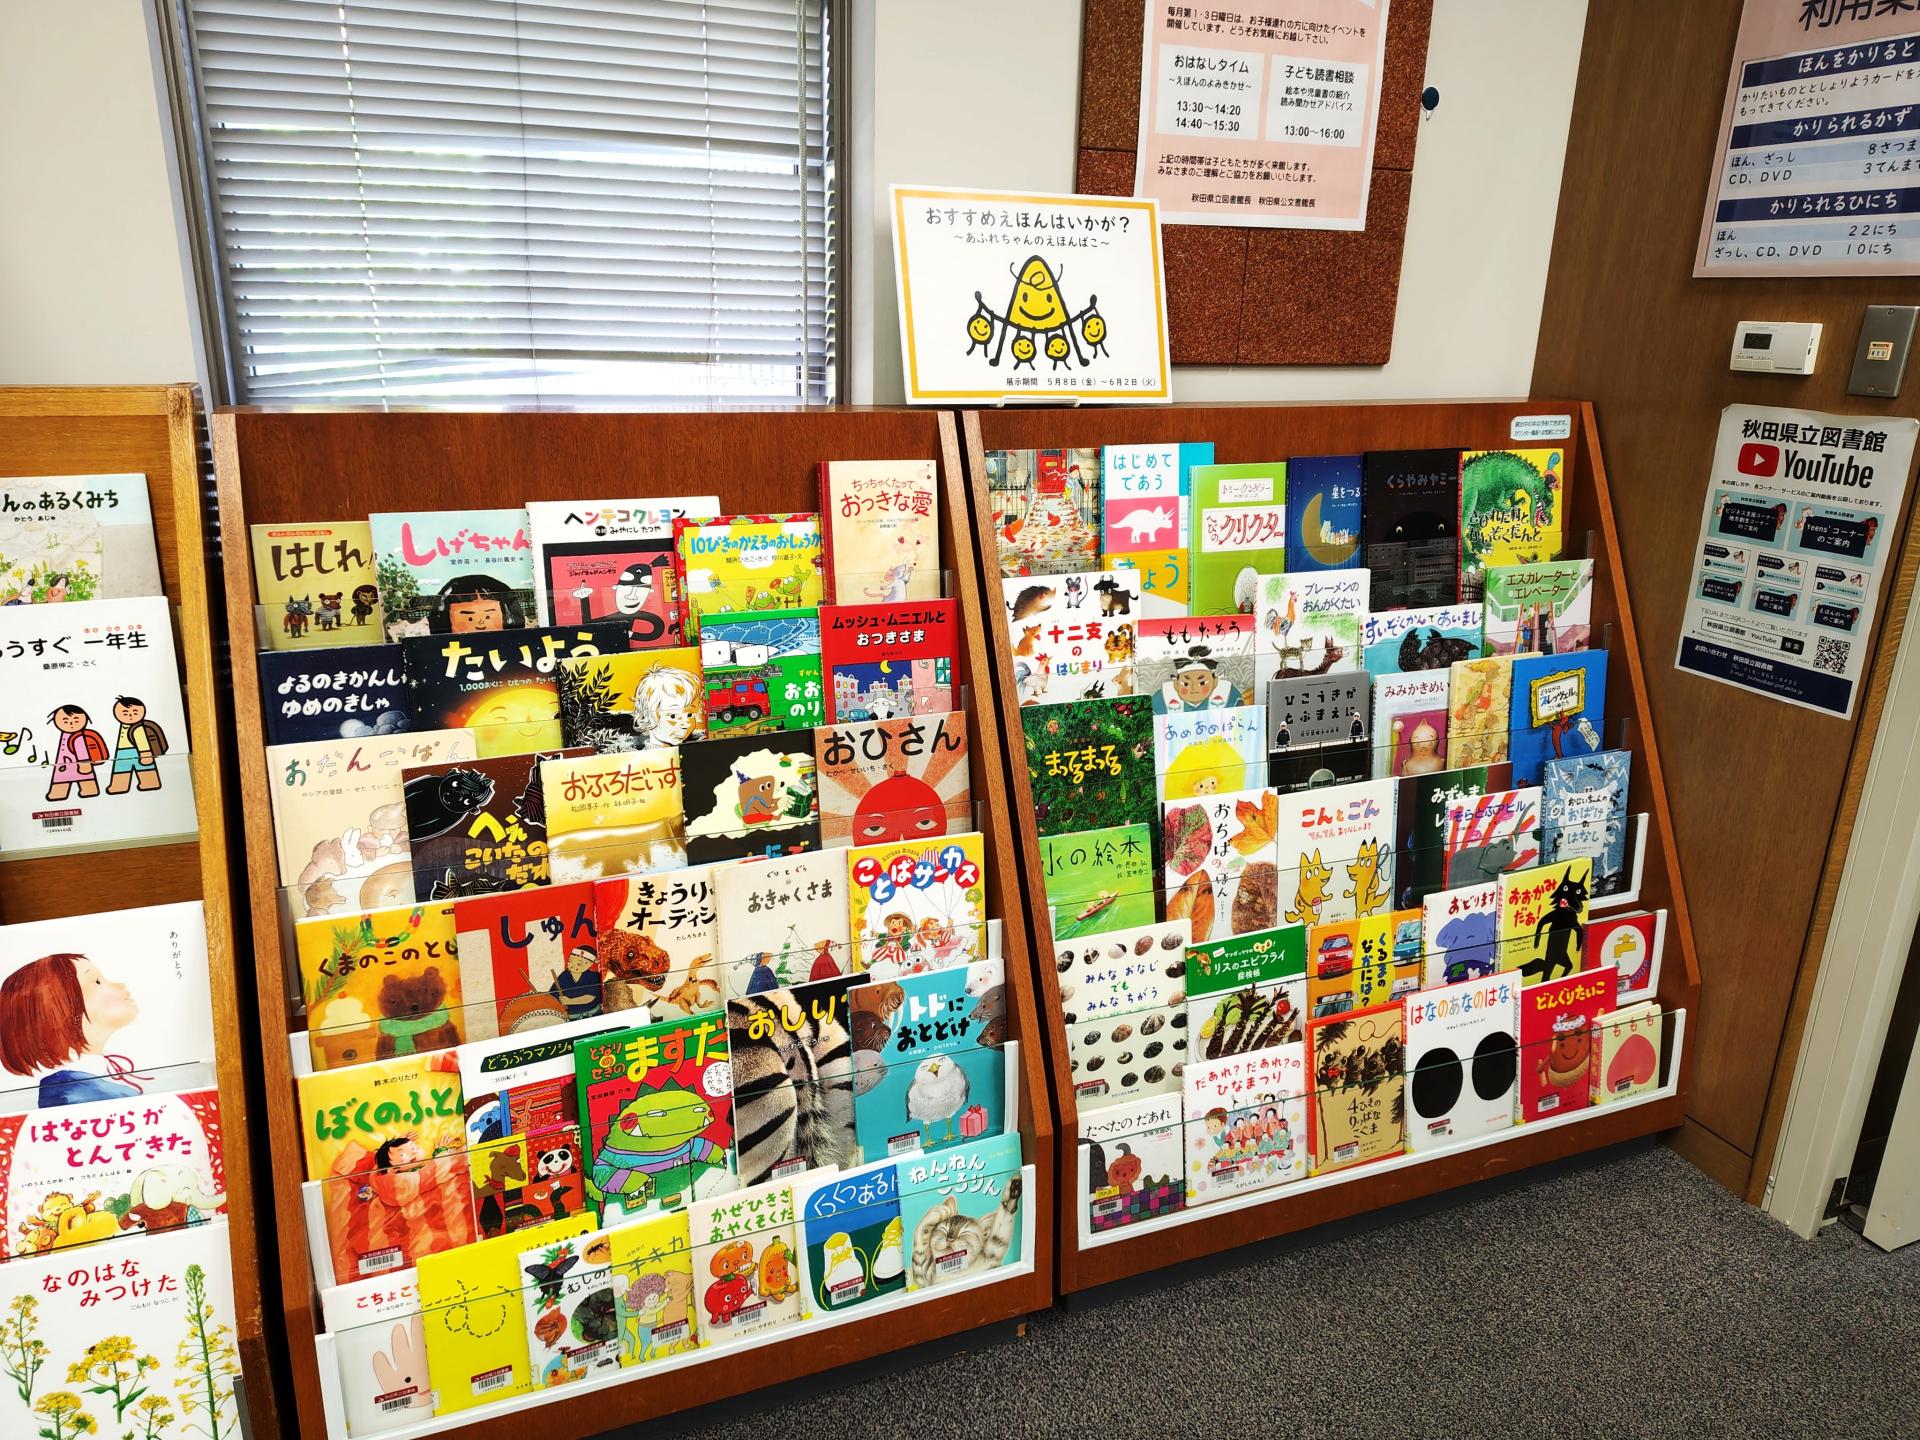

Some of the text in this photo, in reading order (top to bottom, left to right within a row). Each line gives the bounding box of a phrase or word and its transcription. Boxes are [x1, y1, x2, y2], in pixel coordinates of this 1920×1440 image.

[1174, 55, 1249, 74] おはなしタイム
[1284, 65, 1355, 84] 子ども読書相談
[1280, 97, 1353, 111] 読み聞かせアドバイス
[1285, 86, 1350, 100] 絵本や児童書の紹介
[1740, 98, 1829, 117] もってきてください。
[1793, 106, 1912, 137] かりられるかず
[1770, 192, 1897, 215] かりられるひにち
[925, 207, 1130, 233] おすすめえほんはいかが？
[1717, 230, 1737, 241] ほん
[1006, 377, 1038, 387] 展示期間
[1741, 419, 1887, 453] 秋田県立図書館
[1113, 452, 1173, 470] はじめて
[1784, 448, 1874, 489] YouTube
[851, 478, 914, 490] ちっちゃくたって
[1121, 473, 1164, 491] であう
[2, 488, 119, 512] んのあるくみち
[840, 490, 932, 518] おっきな愛
[563, 508, 686, 528] ヘンテコクレヨン
[1219, 512, 1284, 546] クリクター
[401, 522, 530, 567] しげちゃん
[1304, 581, 1360, 596] ブレーメンの
[1506, 569, 1578, 586] エスカレーターと
[1302, 596, 1361, 612] おんがくたい
[1514, 585, 1569, 600] エレベーター
[832, 613, 947, 631] ムッシュ・ムニエルと
[1048, 621, 1102, 643] 十二支
[1162, 620, 1241, 646] ももたろう
[1365, 609, 1484, 646] すいぞくかんであいまし
[84, 631, 149, 650] 一年生
[856, 631, 925, 646] おつきさま
[1072, 645, 1082, 657] の
[1056, 659, 1102, 676] はじまり
[1284, 688, 1358, 706] ひこうきが
[1384, 681, 1451, 699] みみかきめい
[281, 694, 390, 719] ゆめのきしゃ
[1285, 705, 1355, 726] とぶまえに
[823, 718, 961, 767] おひさん
[284, 740, 471, 788] おだんごぱん
[1044, 744, 1122, 785] まってるまってる
[562, 757, 681, 802] おふろだいす
[1301, 799, 1379, 828] こんとごん
[1453, 801, 1525, 822] そらとぶアヒル
[1567, 806, 1604, 822] おばけ
[1567, 829, 1599, 846] はなし
[464, 838, 548, 870] こいたの
[1212, 803, 1232, 899] おちばのほん
[853, 846, 980, 905] ことばサーカス
[747, 880, 833, 914] おきゃくさま
[1448, 889, 1495, 915] おどります
[1508, 878, 1557, 905] おおかみ
[500, 903, 596, 948] しゅん
[168, 930, 183, 981] ありがとう
[1214, 951, 1285, 976] リスのエビフライ
[1376, 933, 1388, 988] くるまの
[1085, 960, 1159, 985] みんな おなじ
[1087, 986, 1159, 1013] みんな ちがう
[1110, 981, 1129, 993] でも
[1536, 980, 1606, 1010] どんぐりたいこ
[748, 992, 846, 1039] おしり
[909, 993, 965, 1021] トドに
[1410, 981, 1517, 1026] はなのあなのはなし
[896, 1016, 970, 1053] おとどけ
[625, 1021, 729, 1082] ますだ
[374, 1073, 419, 1086] 鈴木のりたけ
[1216, 1072, 1282, 1096] ひなまつり
[30, 1104, 167, 1143] はなびらが
[1086, 1113, 1134, 1138] たべたの
[1137, 1109, 1172, 1127] だあれ
[1354, 1124, 1379, 1139] こぐま
[66, 1134, 192, 1168] とんできた
[908, 1152, 987, 1184] ねんねん
[937, 1168, 1001, 1198] ころりん
[710, 1188, 792, 1223] かぜひきさ
[709, 1208, 793, 1245] おやくそくだ
[42, 1259, 140, 1293] なのはな
[80, 1273, 178, 1307] みつけた
[356, 1284, 419, 1309] こちょこ
